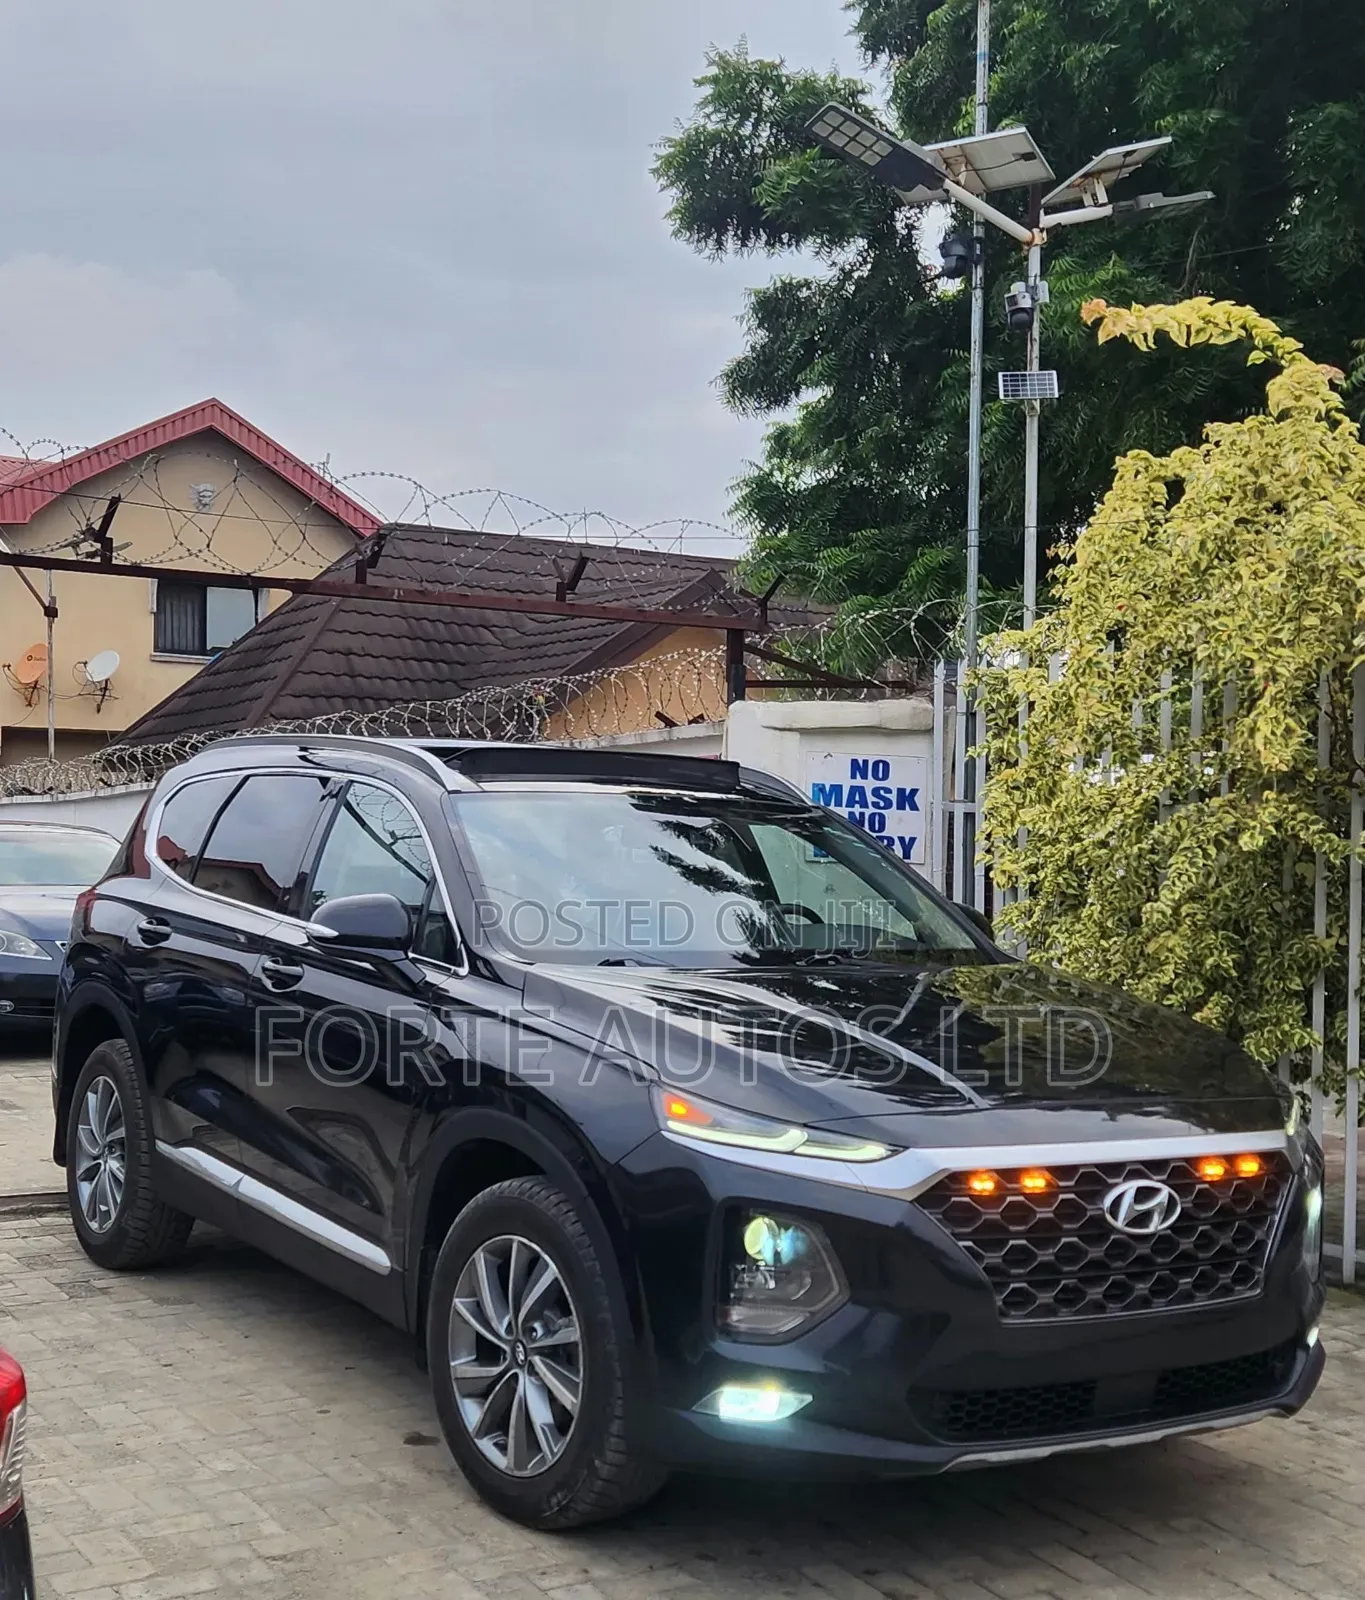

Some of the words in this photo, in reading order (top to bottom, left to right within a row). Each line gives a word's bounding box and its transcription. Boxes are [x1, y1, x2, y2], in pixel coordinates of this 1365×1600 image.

[850, 758, 890, 781] NO
[812, 783, 920, 811] MASK
[848, 811, 886, 833] NO
